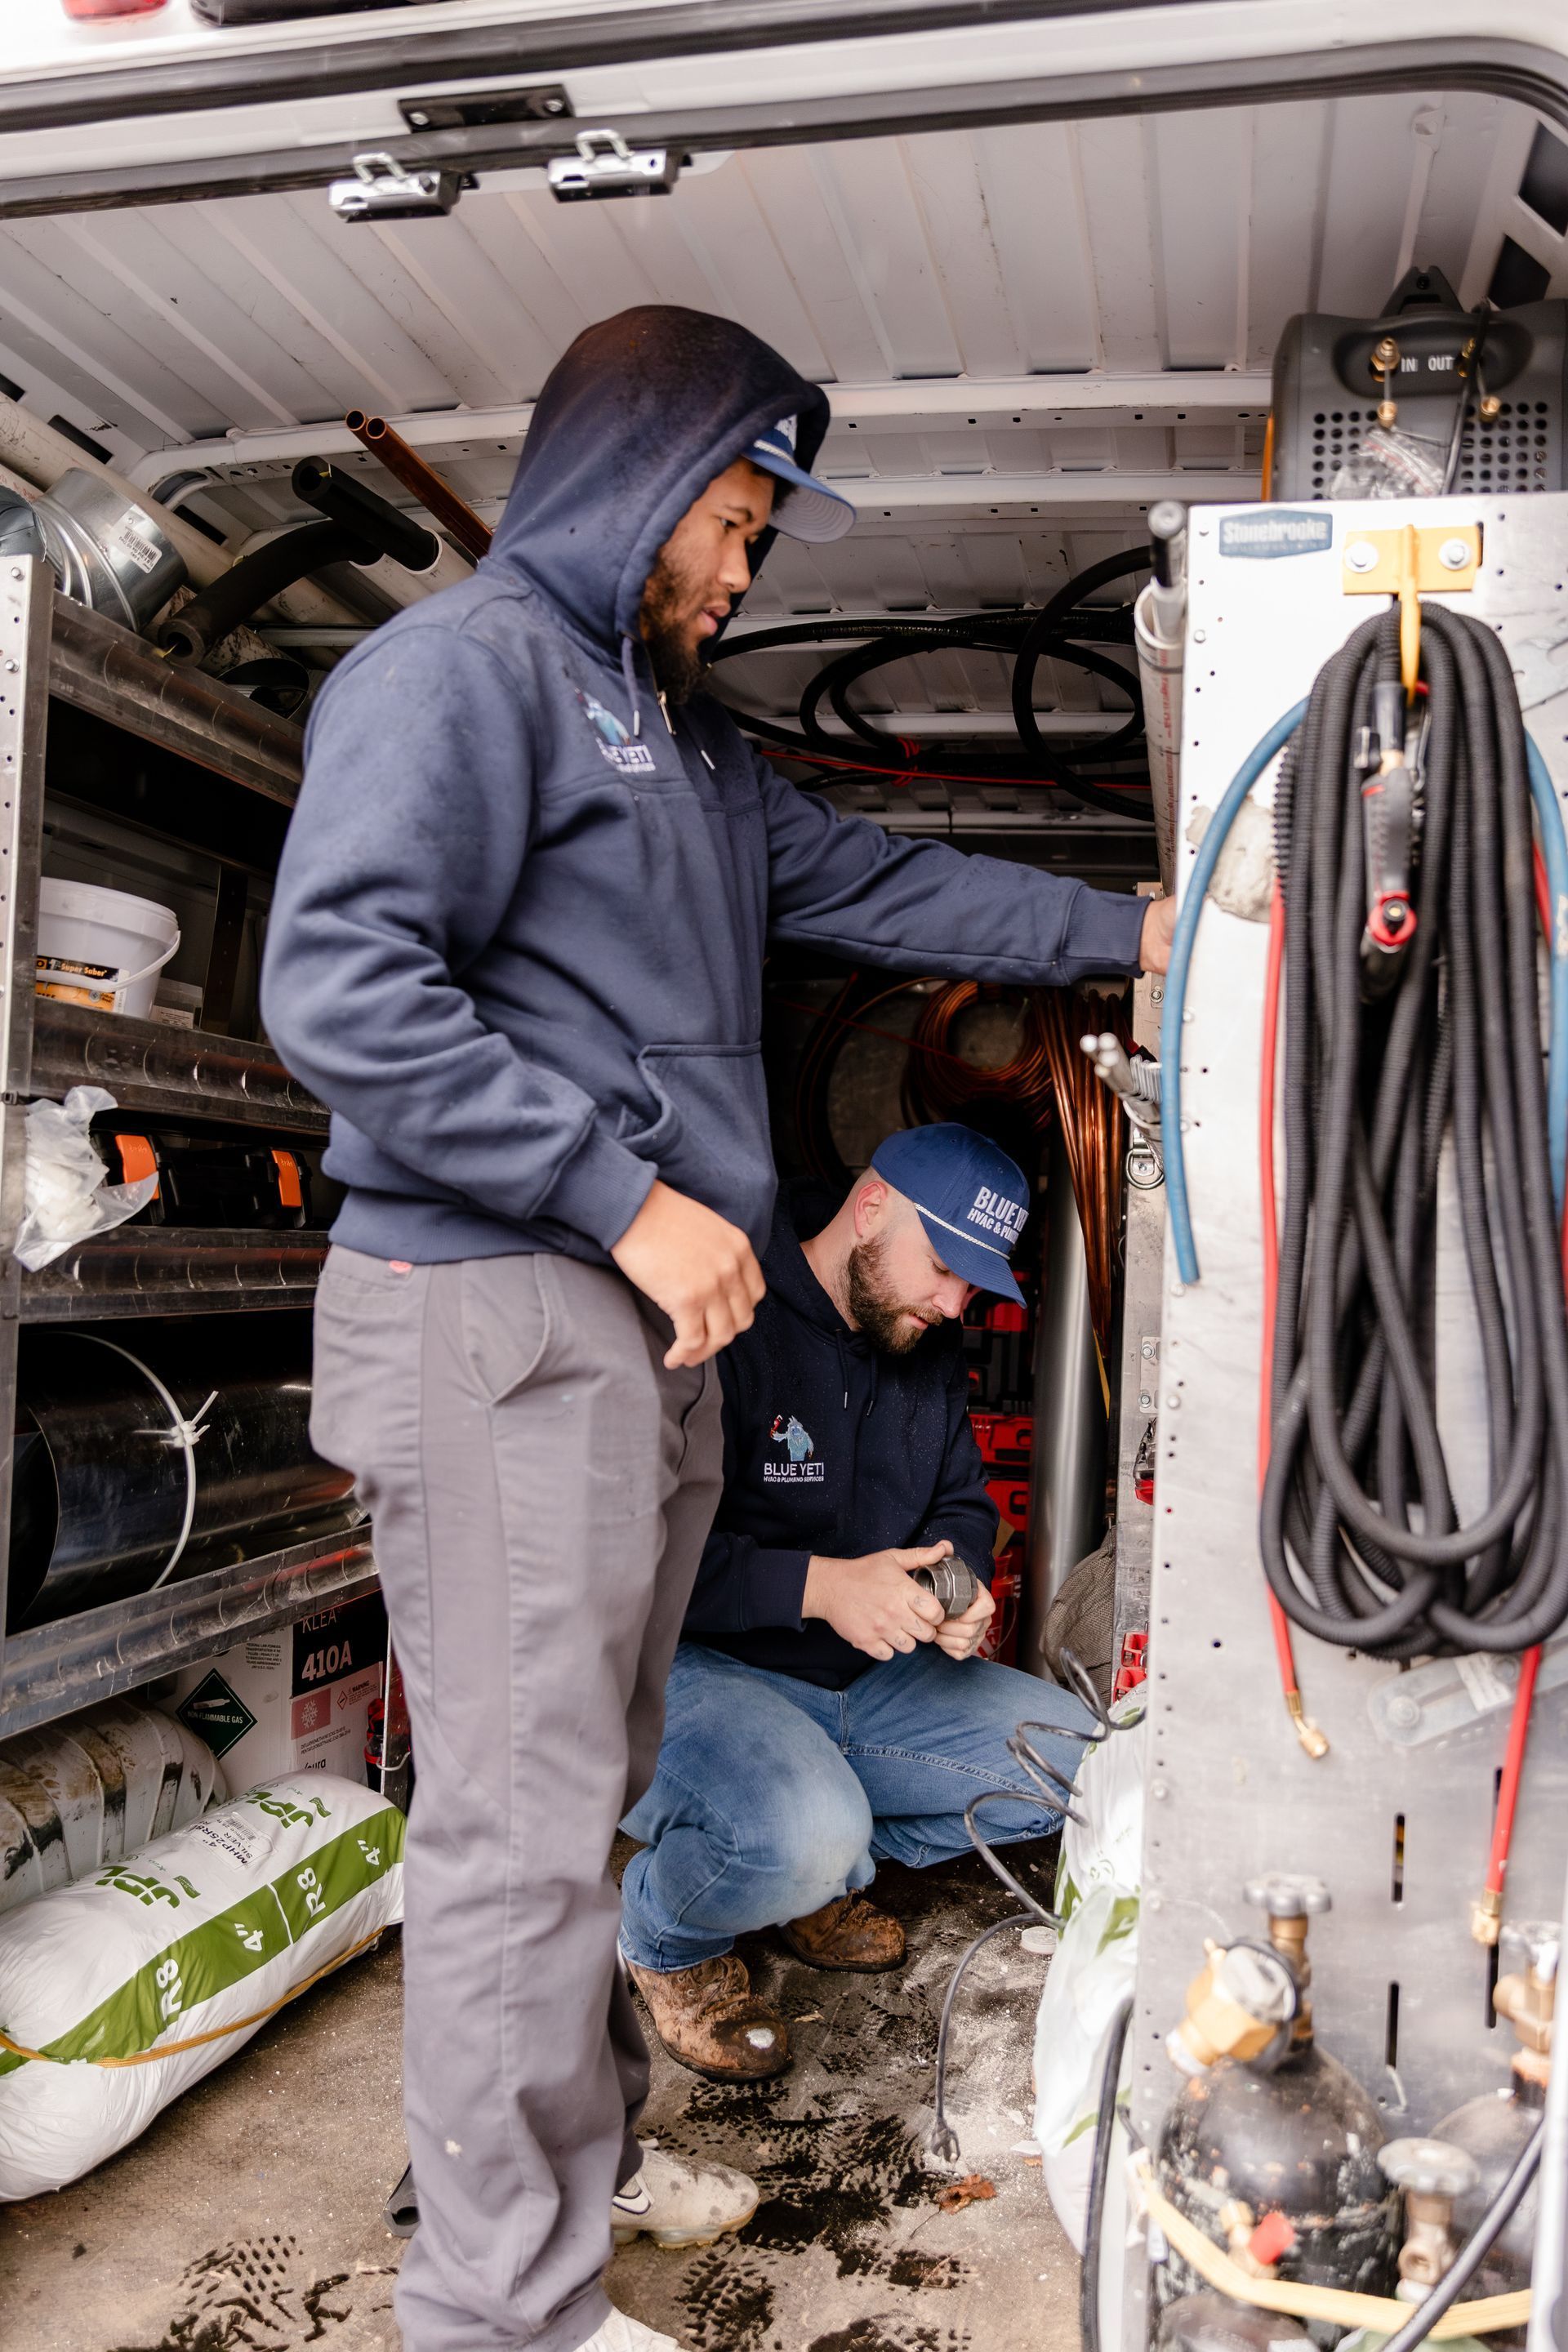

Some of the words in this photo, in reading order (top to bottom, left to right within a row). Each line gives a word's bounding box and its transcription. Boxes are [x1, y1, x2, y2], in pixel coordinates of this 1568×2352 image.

[1401, 358, 1419, 372] IN
[1428, 355, 1454, 371] OUT
[1223, 519, 1327, 544] Stonebrooke
[61, 963, 82, 974] Super
[973, 1187, 1020, 1225] BLUE
[966, 1208, 995, 1230] HVAC
[992, 1222, 1001, 1235] &
[764, 1463, 797, 1476] BLUE
[800, 1462, 824, 1476] YETI
[302, 1609, 336, 1633] KLEA
[301, 1640, 353, 1682] 410A
[232, 1716, 243, 1724] GAS
[224, 1832, 253, 1859] SILVER
[296, 1867, 327, 1918] R8
[156, 1958, 182, 2021] R8
